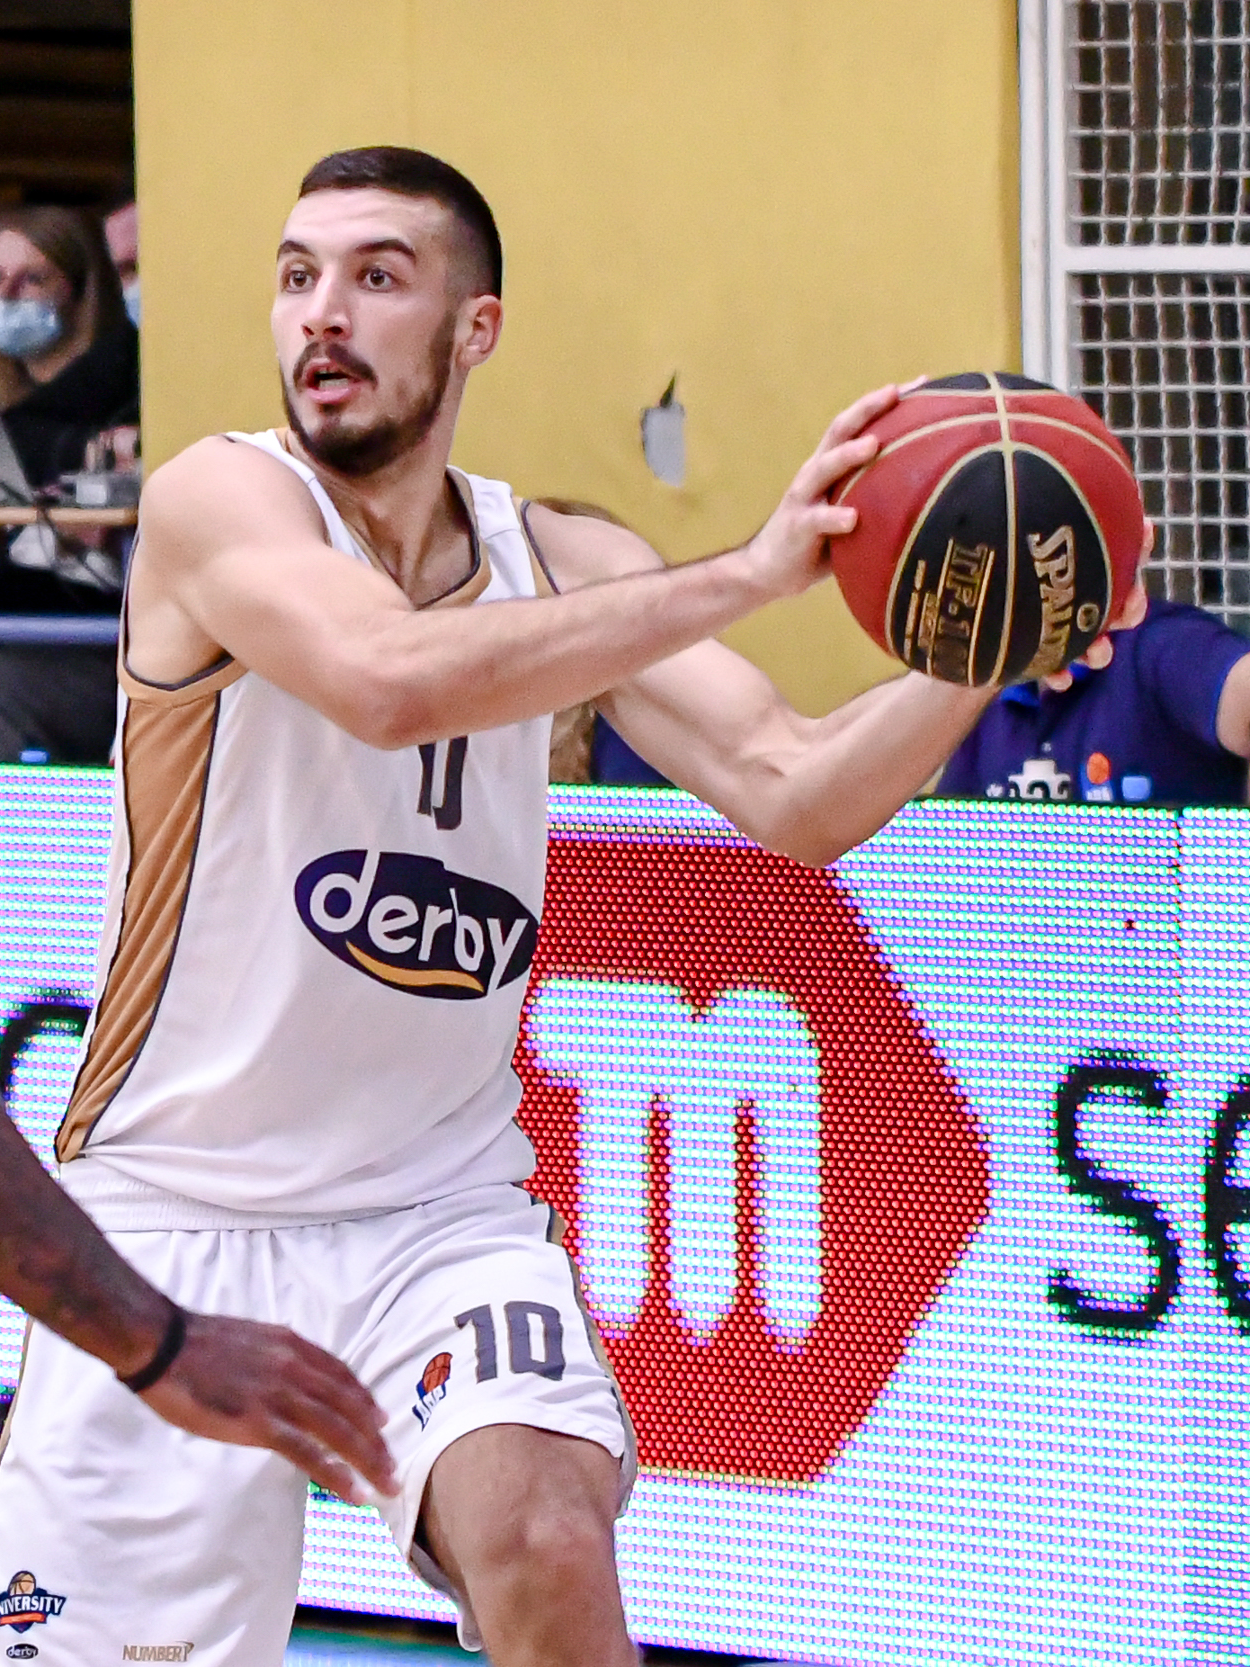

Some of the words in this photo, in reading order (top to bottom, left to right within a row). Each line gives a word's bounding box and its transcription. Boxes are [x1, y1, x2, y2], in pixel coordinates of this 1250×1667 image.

[309, 849, 529, 998] derby
[453, 1300, 566, 1384] 10
[7, 1645, 37, 1659] derby
